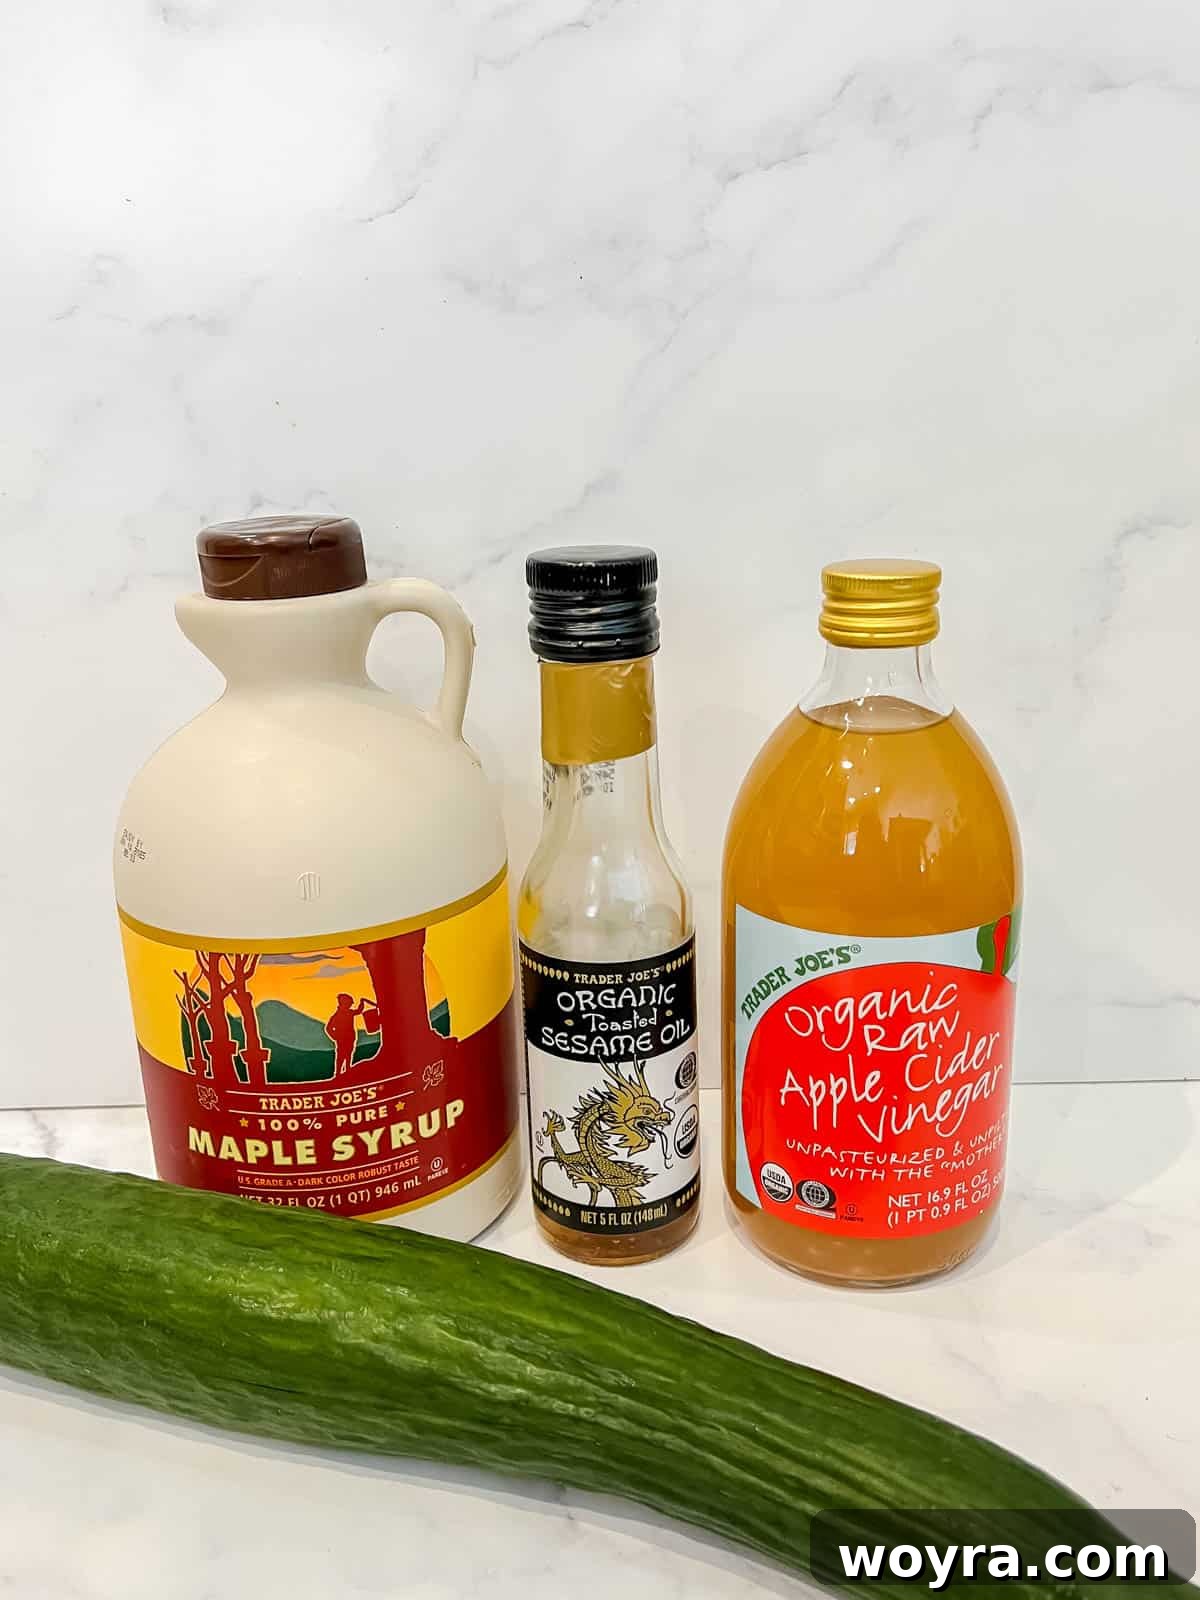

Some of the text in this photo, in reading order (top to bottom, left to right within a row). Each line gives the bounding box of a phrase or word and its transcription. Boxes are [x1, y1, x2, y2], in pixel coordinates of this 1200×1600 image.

[573, 967, 660, 984] TRADER JOE'S
[557, 983, 677, 1012] ORGANIC
[742, 966, 791, 1020] TRADER
[582, 1007, 657, 1032] Toasted
[784, 971, 958, 1051] Organic
[541, 1018, 690, 1056] SESAME OIL
[780, 1031, 1000, 1131] Apple Cider
[259, 1087, 377, 1110] TRADER JOE'S
[188, 1099, 464, 1165] MAPLE SYRUP
[258, 1105, 388, 1131] 100% PURE
[786, 1139, 944, 1165] UNPASTEURIZED
[254, 1177, 284, 1186] GRADE
[326, 1173, 356, 1184] COLOR
[358, 1164, 391, 1180] ROBUST
[393, 1155, 419, 1169] TASTE
[830, 1167, 885, 1181] WITH
[893, 1164, 934, 1181] THE
[307, 1196, 325, 1208] OZ
[330, 1194, 341, 1208] (1
[348, 1189, 370, 1204] QT)
[375, 1182, 399, 1198] 946
[403, 1175, 421, 1190] mL
[888, 1193, 922, 1208] NET
[928, 1187, 950, 1204] 16.9
[955, 1182, 968, 1196] FL
[971, 1169, 988, 1188] OZ
[580, 1210, 597, 1224] NET
[600, 1212, 606, 1225] 5
[608, 1212, 620, 1225] FL
[621, 1212, 632, 1225] OZ
[887, 1183, 991, 1229] (1 PT 0.9 FL OZ)
